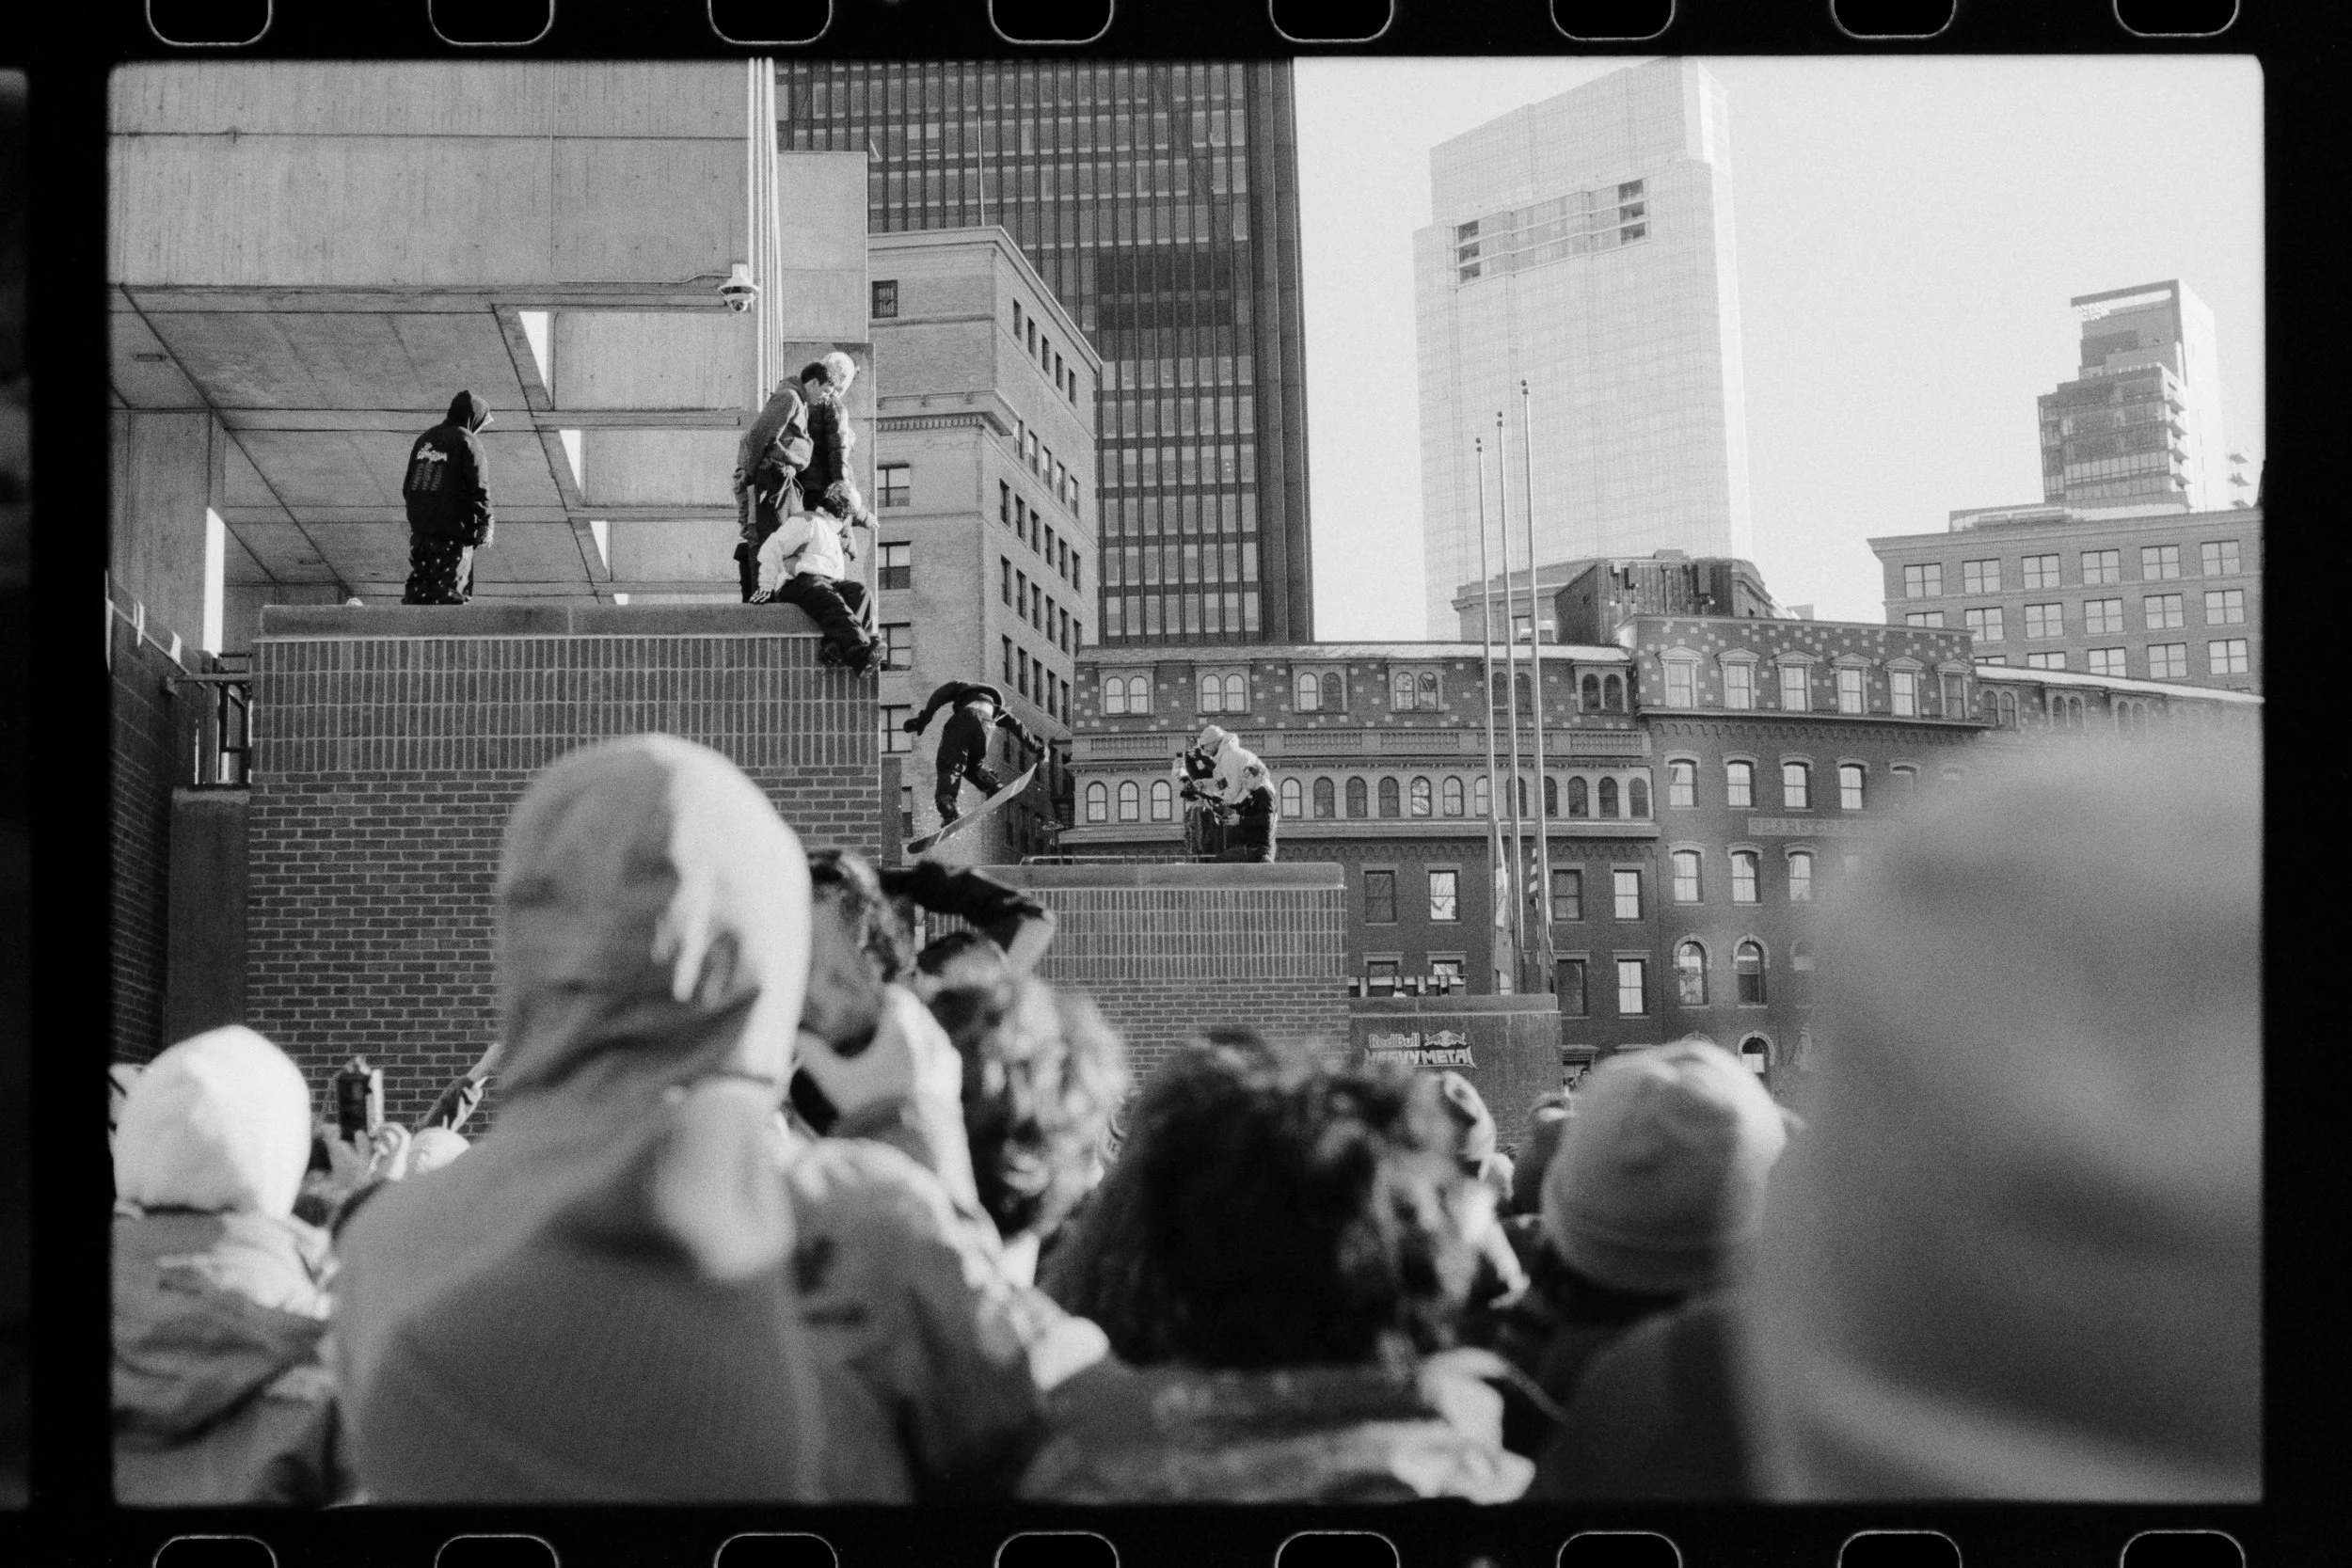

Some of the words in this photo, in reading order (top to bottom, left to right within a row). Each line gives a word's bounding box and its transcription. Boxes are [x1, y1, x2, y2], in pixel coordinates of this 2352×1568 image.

[1369, 1034, 1394, 1048] Red
[1394, 1033, 1420, 1047] Bull
[1421, 1046, 1479, 1069] METAL
